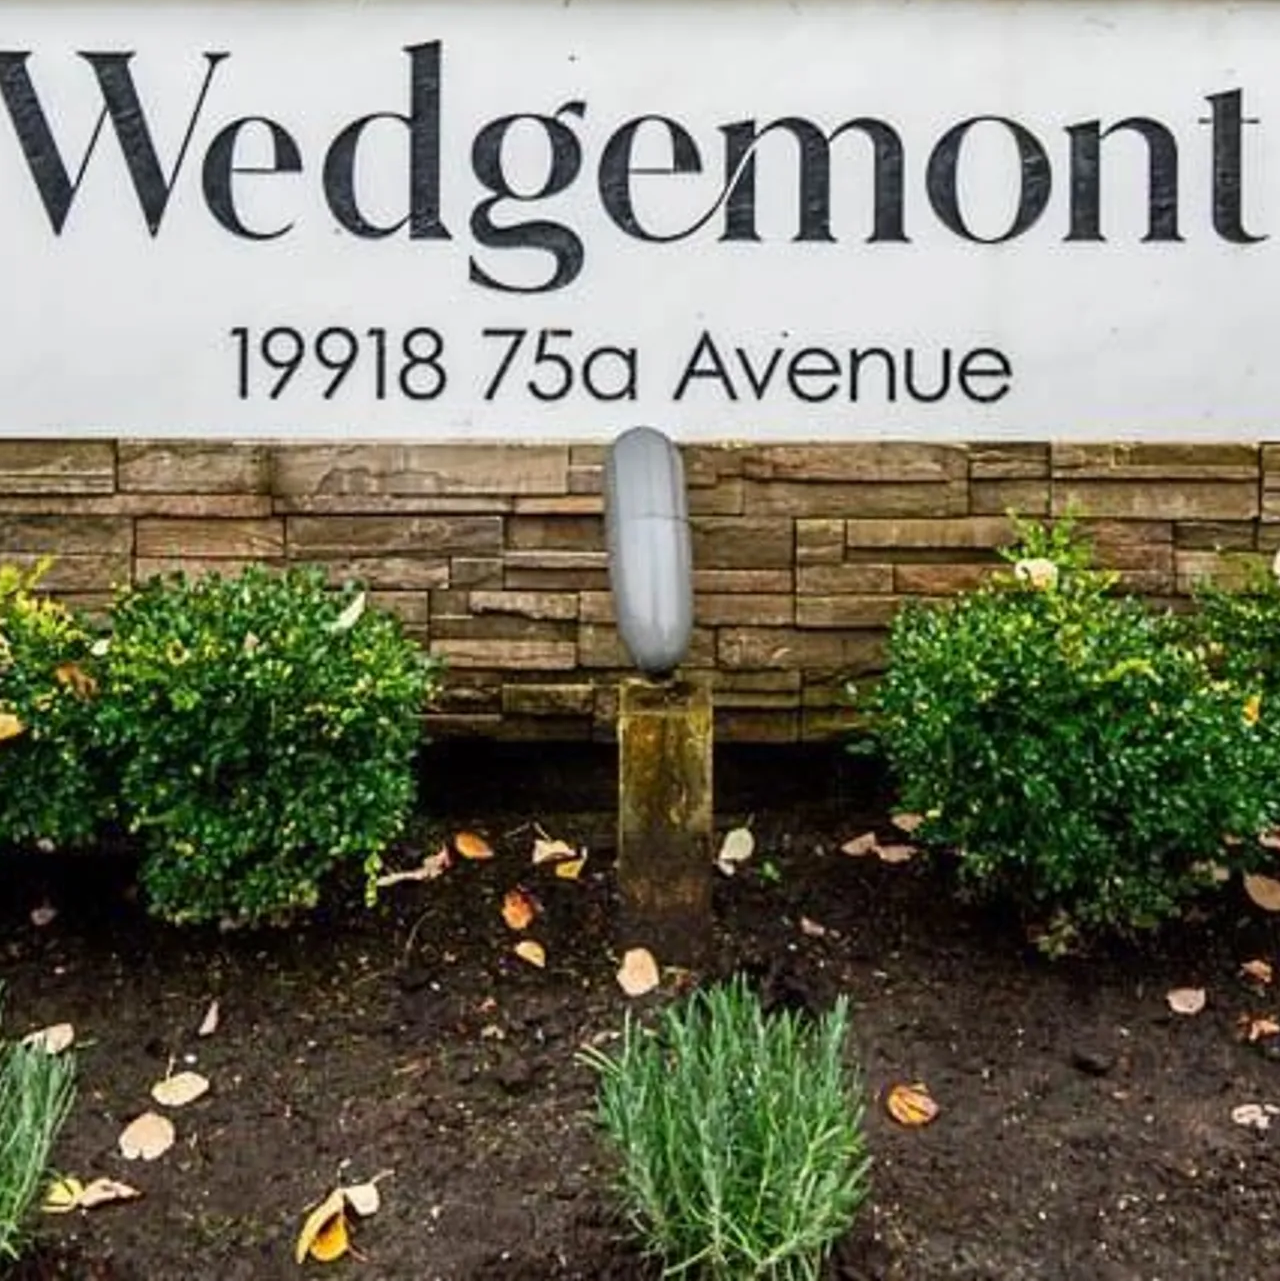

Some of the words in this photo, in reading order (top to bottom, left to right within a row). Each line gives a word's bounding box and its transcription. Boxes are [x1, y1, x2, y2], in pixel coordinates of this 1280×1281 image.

[230, 326, 447, 400] 19918
[482, 328, 638, 402] 75a
[672, 331, 1013, 404] Avenue
